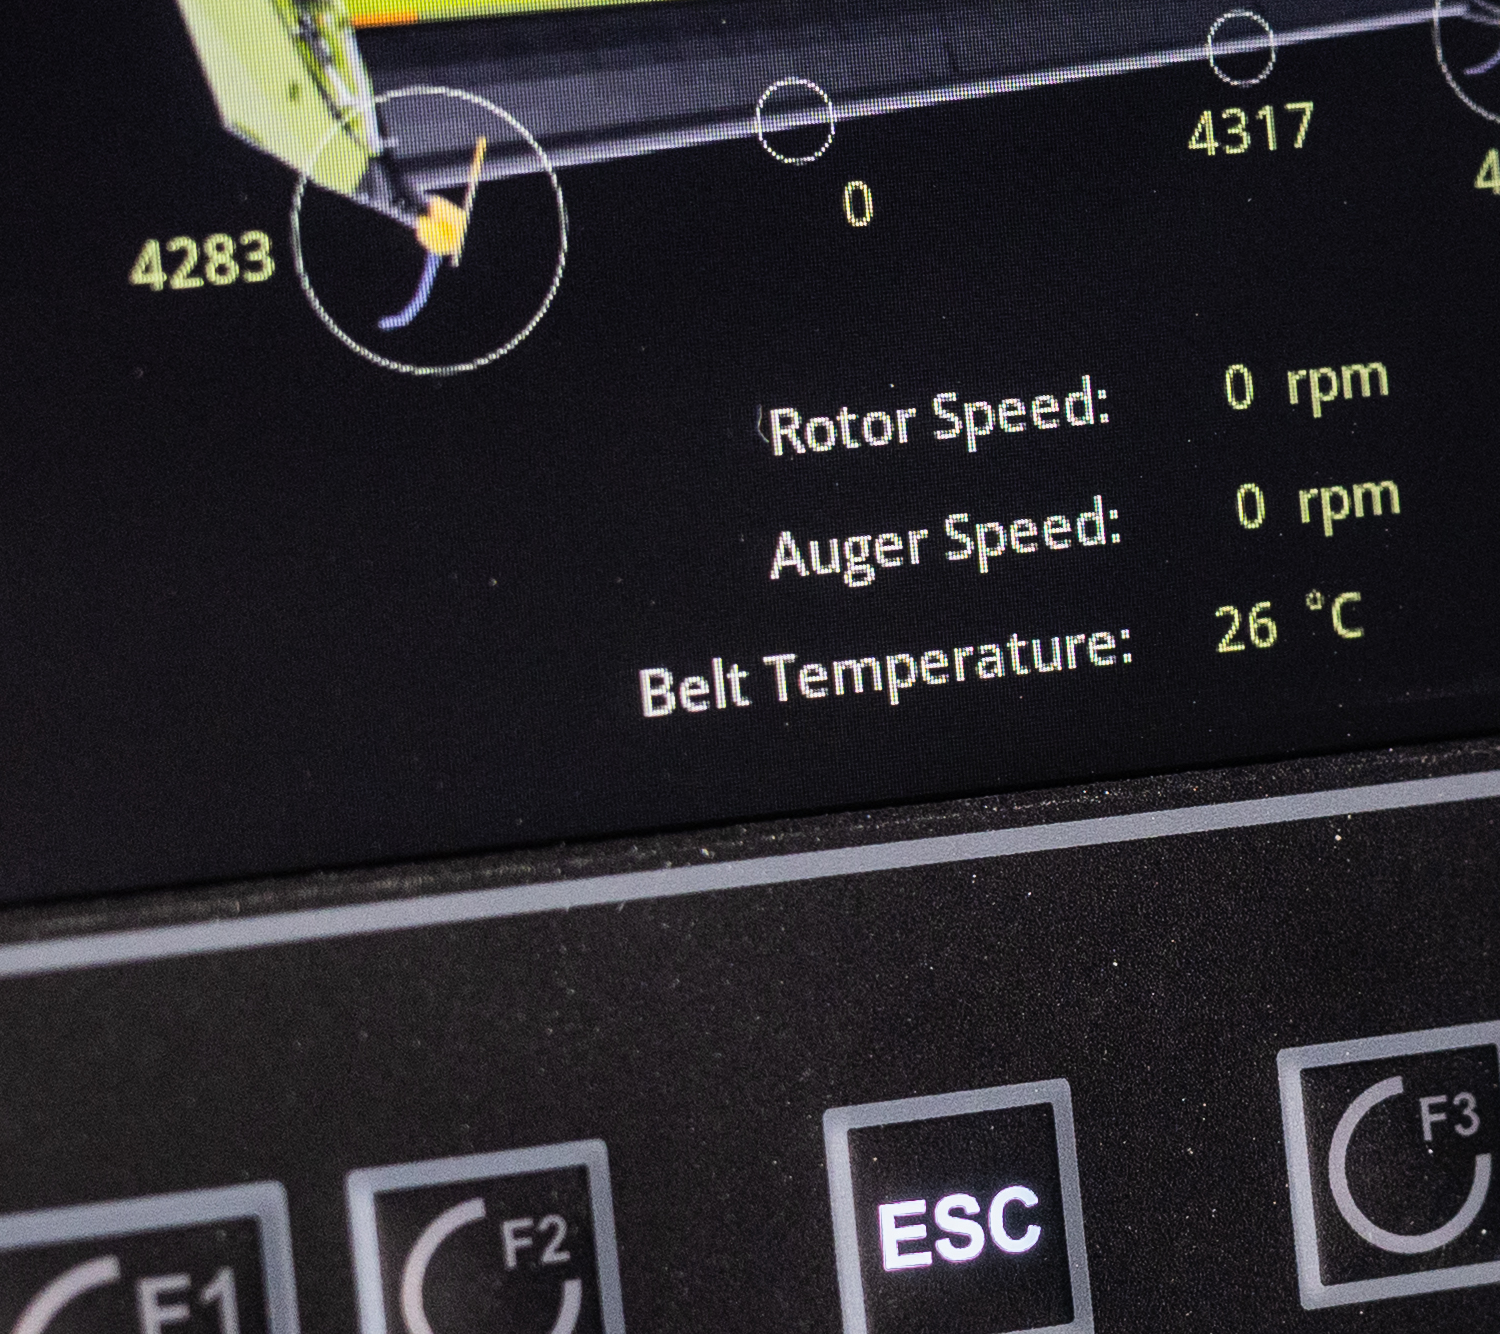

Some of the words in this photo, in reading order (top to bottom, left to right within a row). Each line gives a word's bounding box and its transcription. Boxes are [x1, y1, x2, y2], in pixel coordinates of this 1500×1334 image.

[1187, 99, 1315, 157] 4317
[842, 178, 876, 229] 0
[129, 229, 276, 291] 4283
[768, 406, 918, 457] Rotor
[931, 374, 1110, 454] Speed:
[1223, 362, 1256, 412] 0
[1286, 361, 1390, 419] rpm
[769, 528, 929, 589] Auger
[943, 494, 1122, 575] Speed:
[1235, 481, 1267, 531] 0
[1297, 479, 1402, 538] rpm
[638, 656, 751, 719] Belt
[761, 628, 1133, 707] Temperature:
[1214, 599, 1279, 654] 26
[1418, 1091, 1481, 1142] F3
[500, 1214, 570, 1269] F2
[876, 1184, 1042, 1273] ESC
